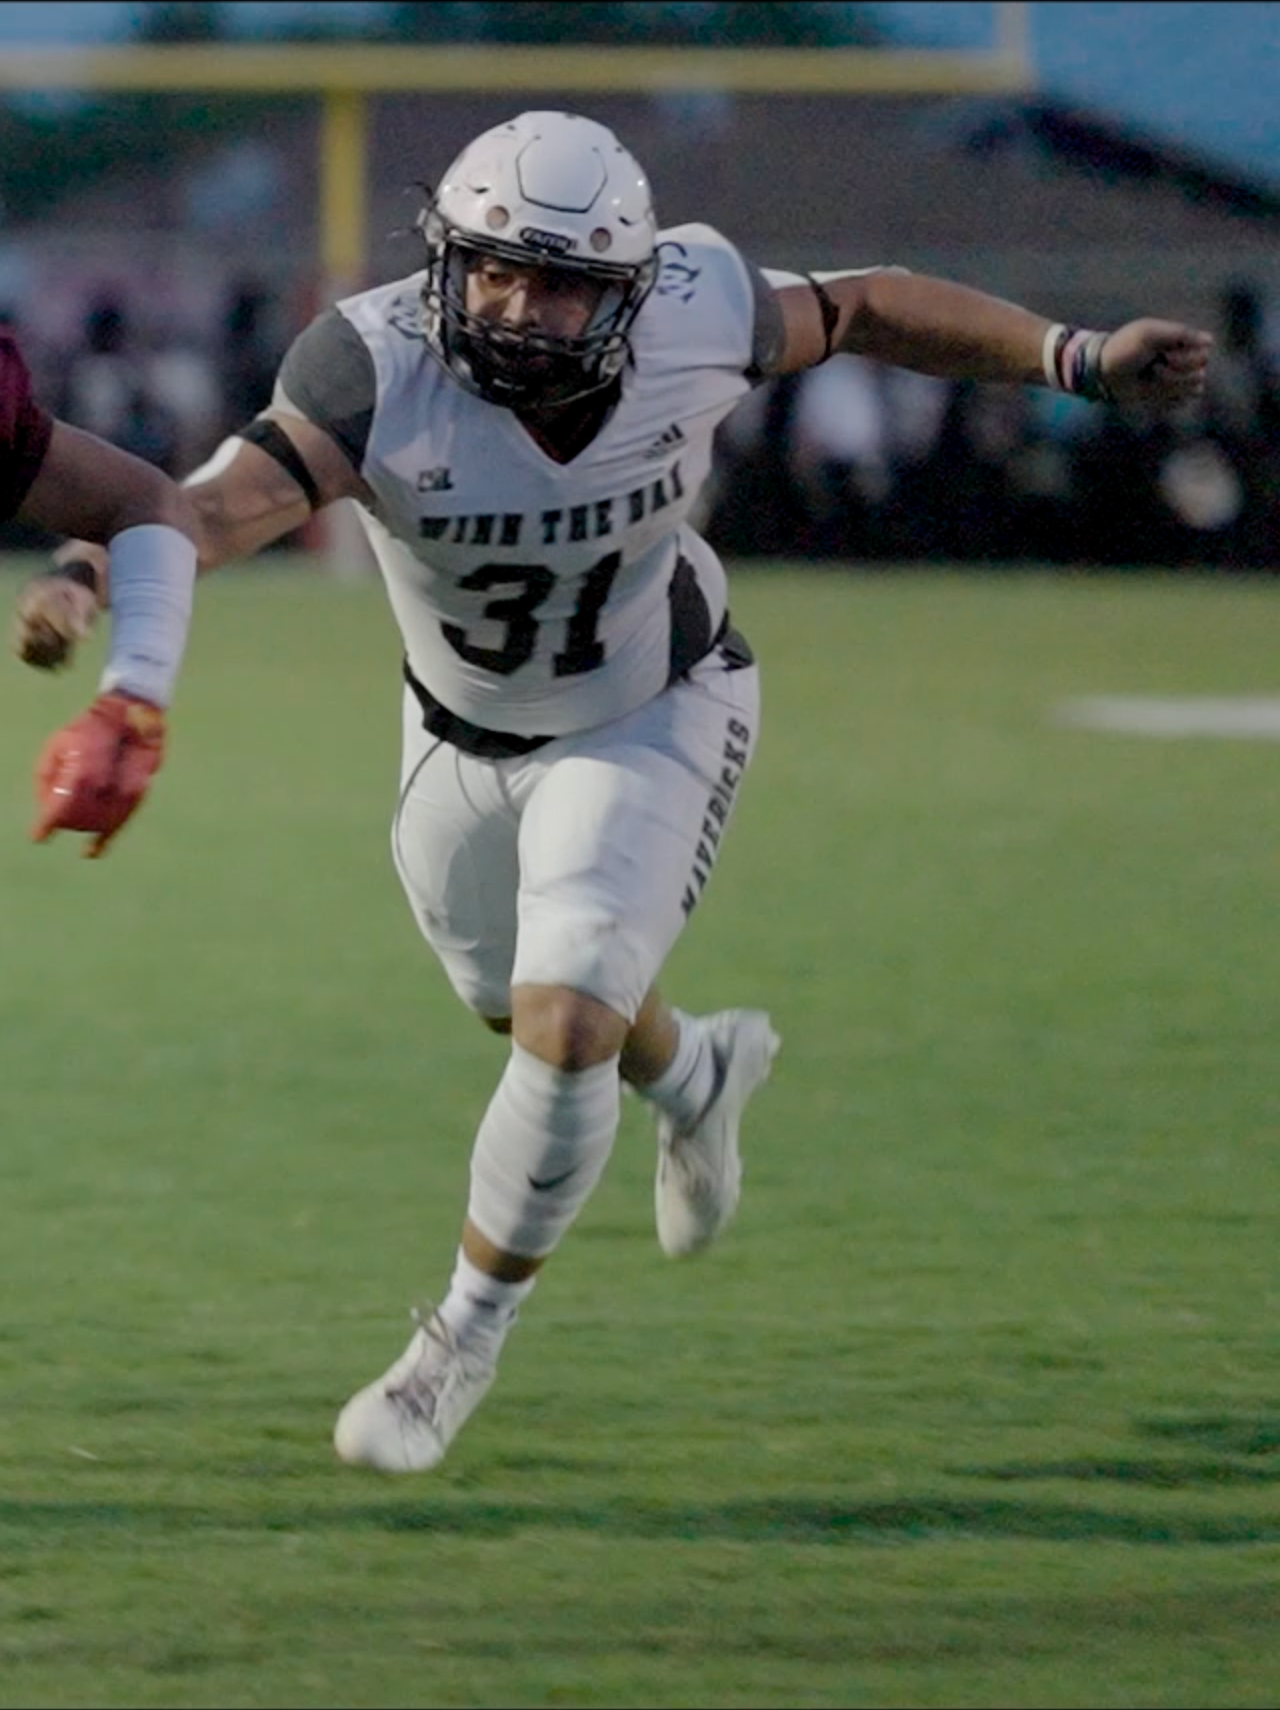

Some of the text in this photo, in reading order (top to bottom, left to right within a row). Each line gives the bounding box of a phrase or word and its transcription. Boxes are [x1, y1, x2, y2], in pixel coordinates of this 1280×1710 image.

[541, 500, 612, 544] THE
[440, 550, 624, 678] 31
[680, 716, 751, 920] MAVERICKS
